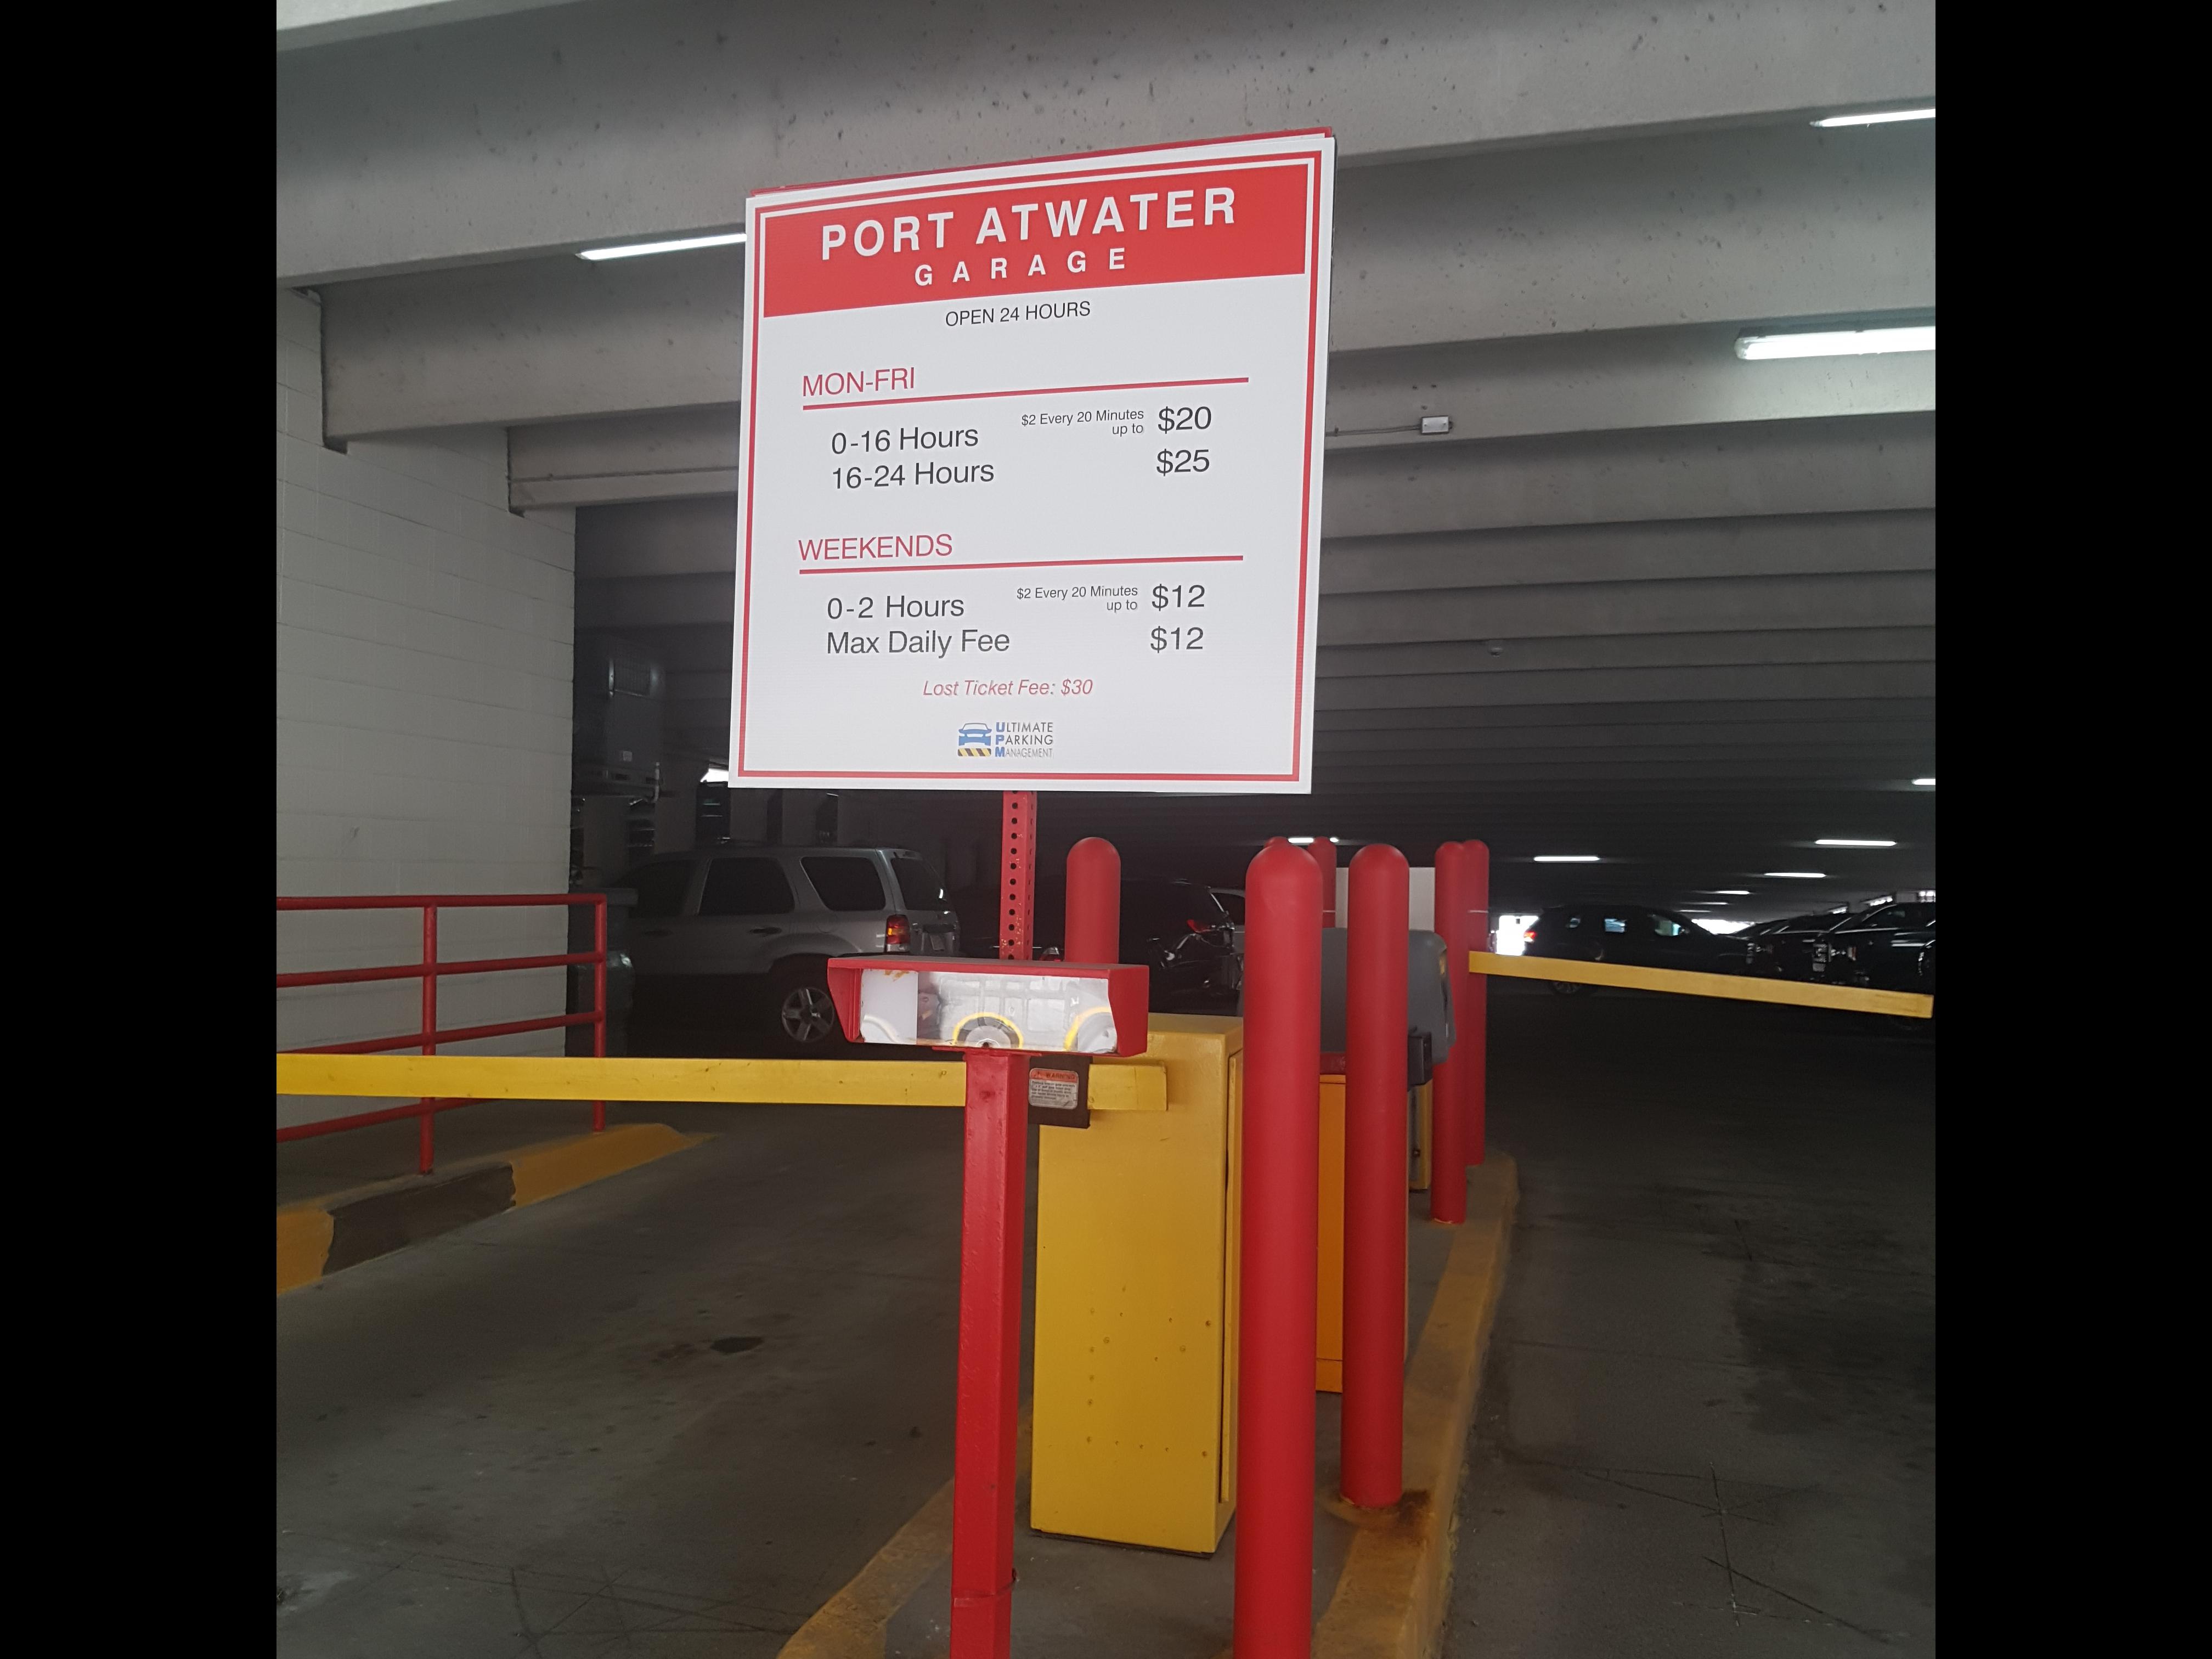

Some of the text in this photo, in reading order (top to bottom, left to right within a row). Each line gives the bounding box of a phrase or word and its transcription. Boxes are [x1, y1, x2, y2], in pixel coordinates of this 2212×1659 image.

[822, 187, 1235, 261] PORT ATWATER
[915, 247, 1125, 286] GARAGE
[945, 301, 1091, 327] OPEN 24 HOURS
[803, 366, 915, 397] MON-FRI
[1022, 409, 1144, 427] $2 Every 20 Minutes
[1112, 423, 1144, 437] up to
[1158, 405, 1212, 435] $20
[832, 426, 978, 455] 0-16 Hours
[832, 461, 994, 489] 16-24 Hours
[1156, 448, 1210, 477] $25
[798, 533, 952, 561] WEEKENDS
[1017, 585, 1138, 601] $2 Every 20 Minutes
[1107, 599, 1138, 613] up to
[1152, 583, 1205, 612] $12
[827, 595, 964, 620] 0-2 Hours
[827, 629, 1010, 659] Max Daily Fee
[1150, 625, 1204, 654] $12
[923, 678, 1093, 696] Lost Ticket Fee: $30
[995, 735, 1053, 745] PARKING
[996, 722, 1053, 732] ULTIMATE
[995, 747, 1053, 758] MANAGEMENT
